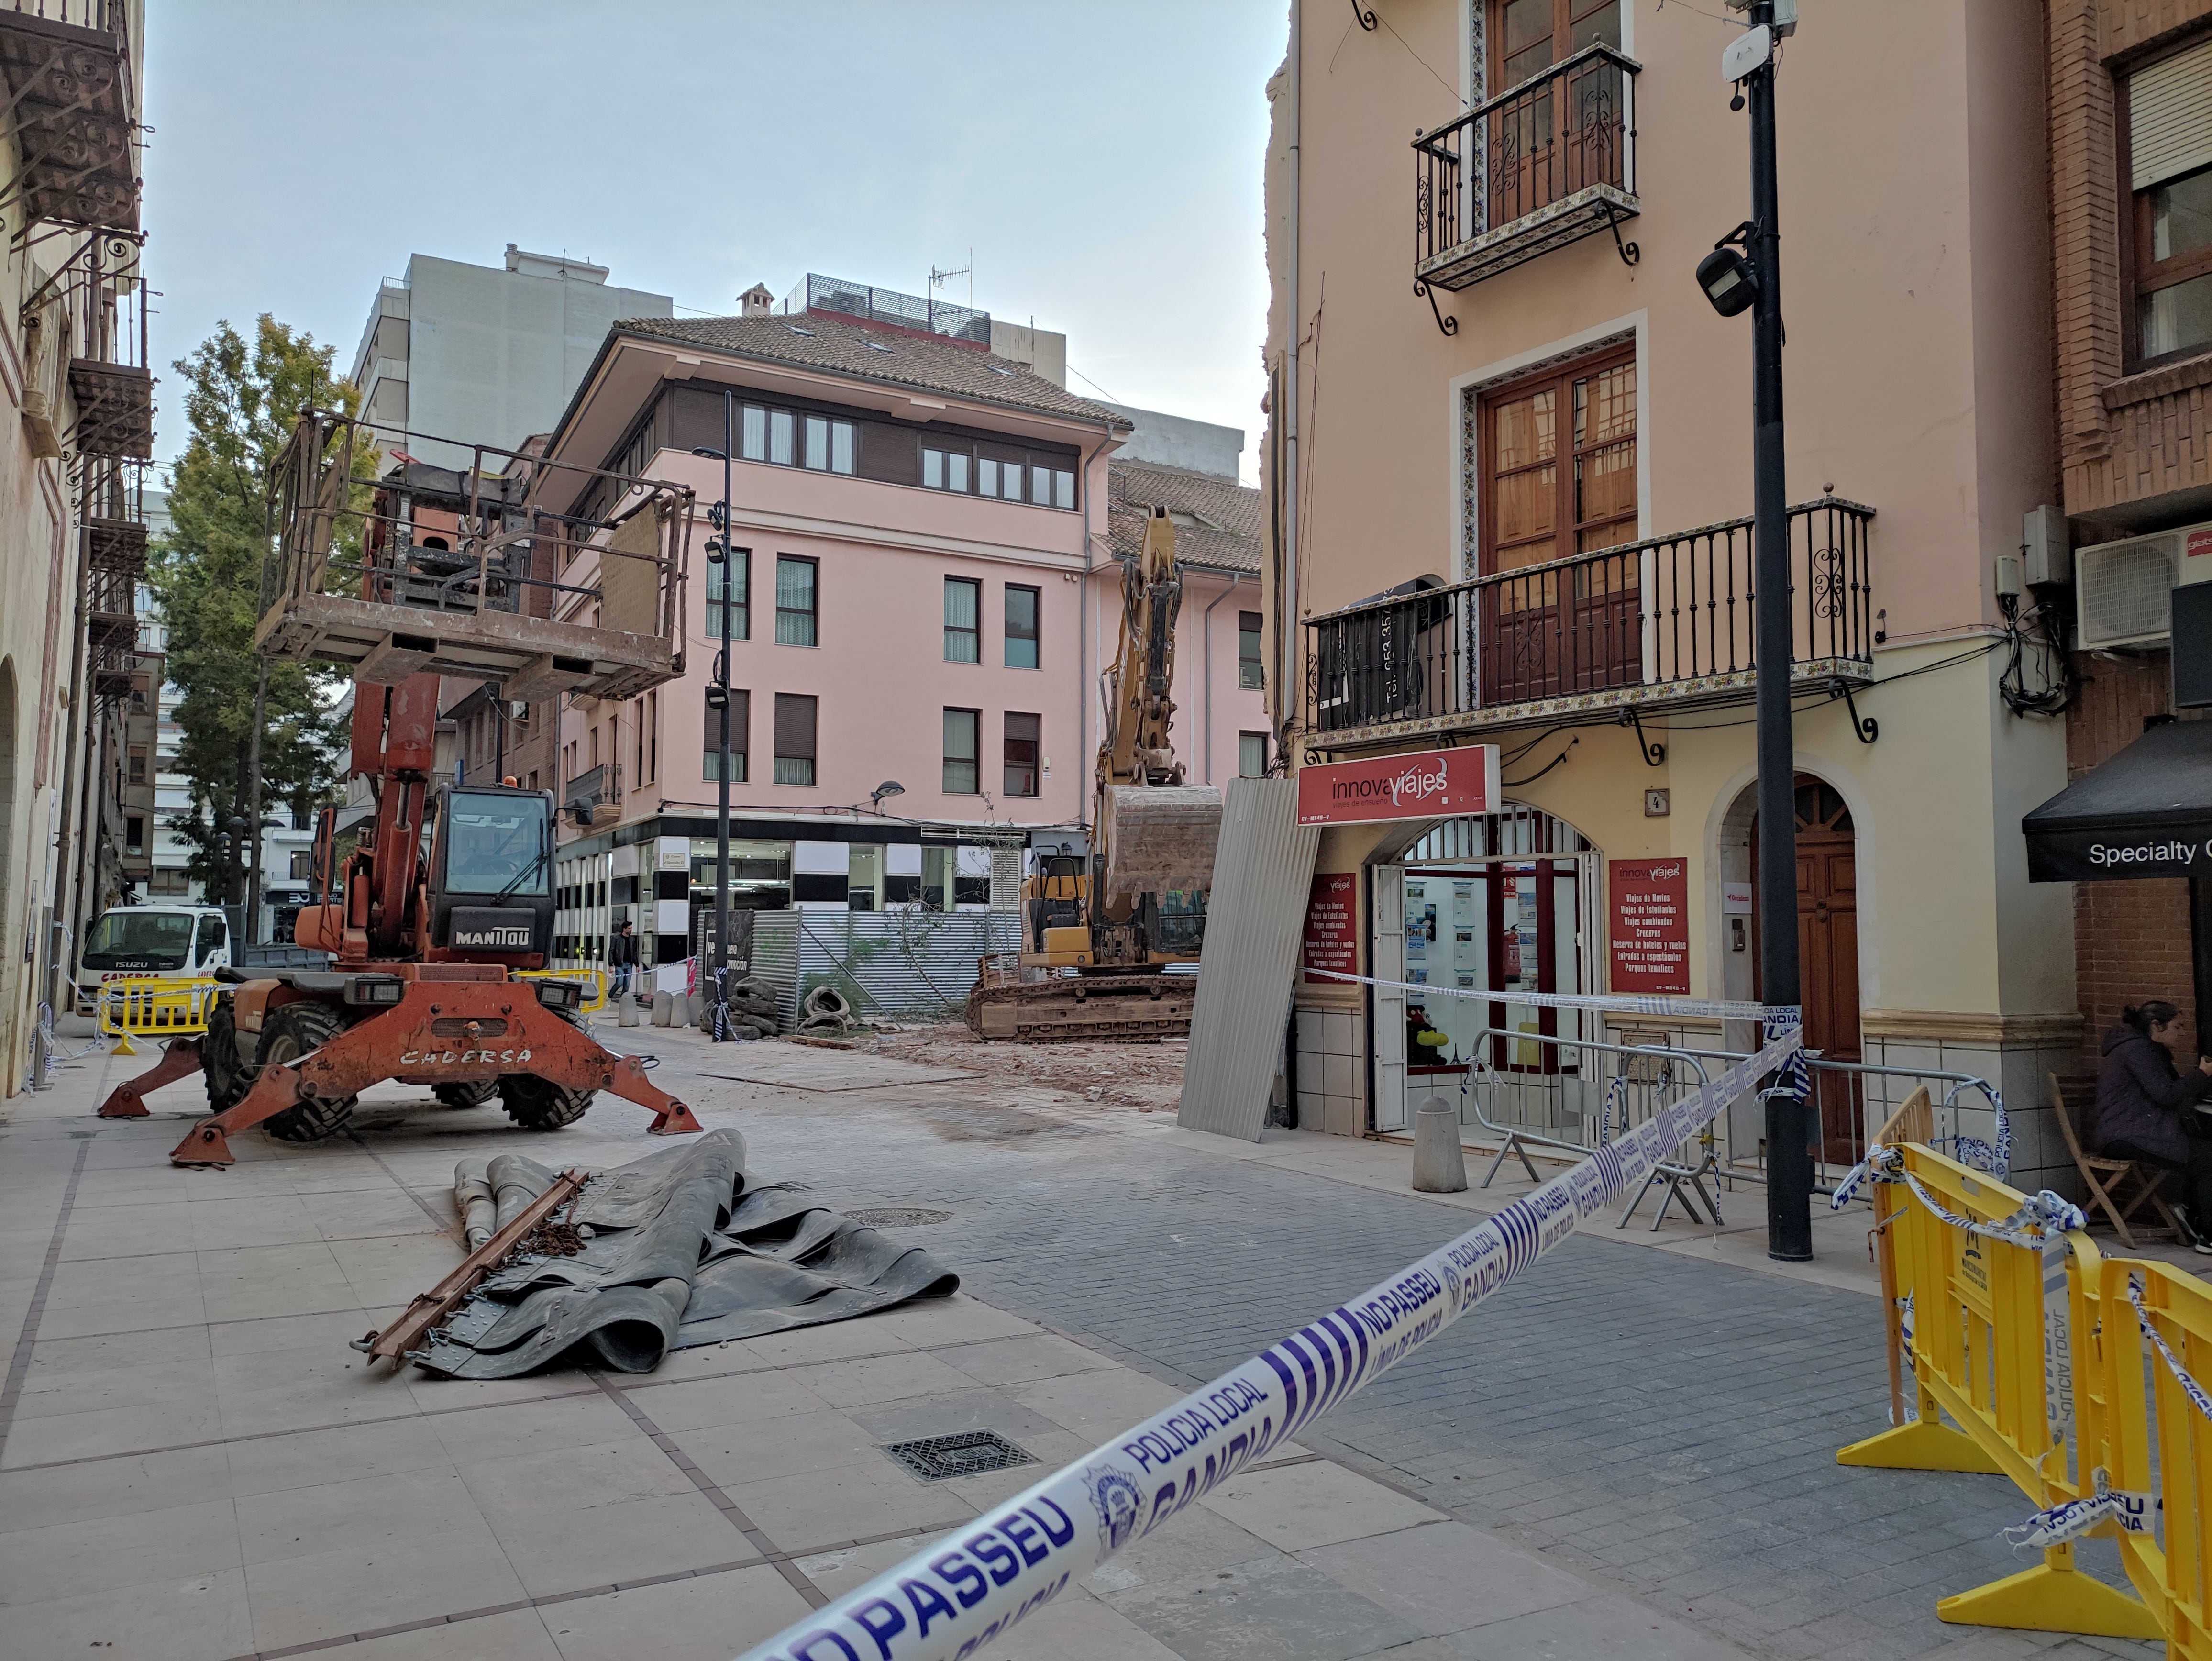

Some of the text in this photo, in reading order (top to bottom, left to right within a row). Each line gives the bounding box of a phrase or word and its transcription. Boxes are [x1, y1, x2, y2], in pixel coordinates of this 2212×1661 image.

[1361, 797, 1388, 806] ensueño
[1653, 796, 1659, 808] 4
[1626, 893, 1670, 904] Viajes de Novios
[1621, 905, 1676, 915] Viajes de Estudiantes
[1624, 917, 1673, 927] Viajes combinados
[456, 927, 530, 945] MANITOU
[1636, 928, 1661, 938] Cruceros
[727, 944, 737, 955] ueva
[1613, 940, 1686, 951] Reserva de hoteles y vuelos
[1618, 952, 1640, 961] Entradas
[727, 956, 748, 971] omoción
[1625, 963, 1647, 974] Parques
[1763, 1015, 1799, 1024] ANDIA
[400, 1049, 532, 1065] CADERSA
[1995, 1128, 2005, 1158] POLICIA
[1530, 1184, 1570, 1224] NO PASSEU
[1581, 1182, 1605, 1218] GANDIA
[1448, 1230, 1500, 1271] POLICIA LOCAL
[1461, 1255, 1504, 1312] GANDIA
[1354, 1268, 1441, 1339] NO PASSEU
[1122, 1377, 1269, 1474] POLICIA LOCAL
[845, 1495, 1075, 1661] PASSEU
